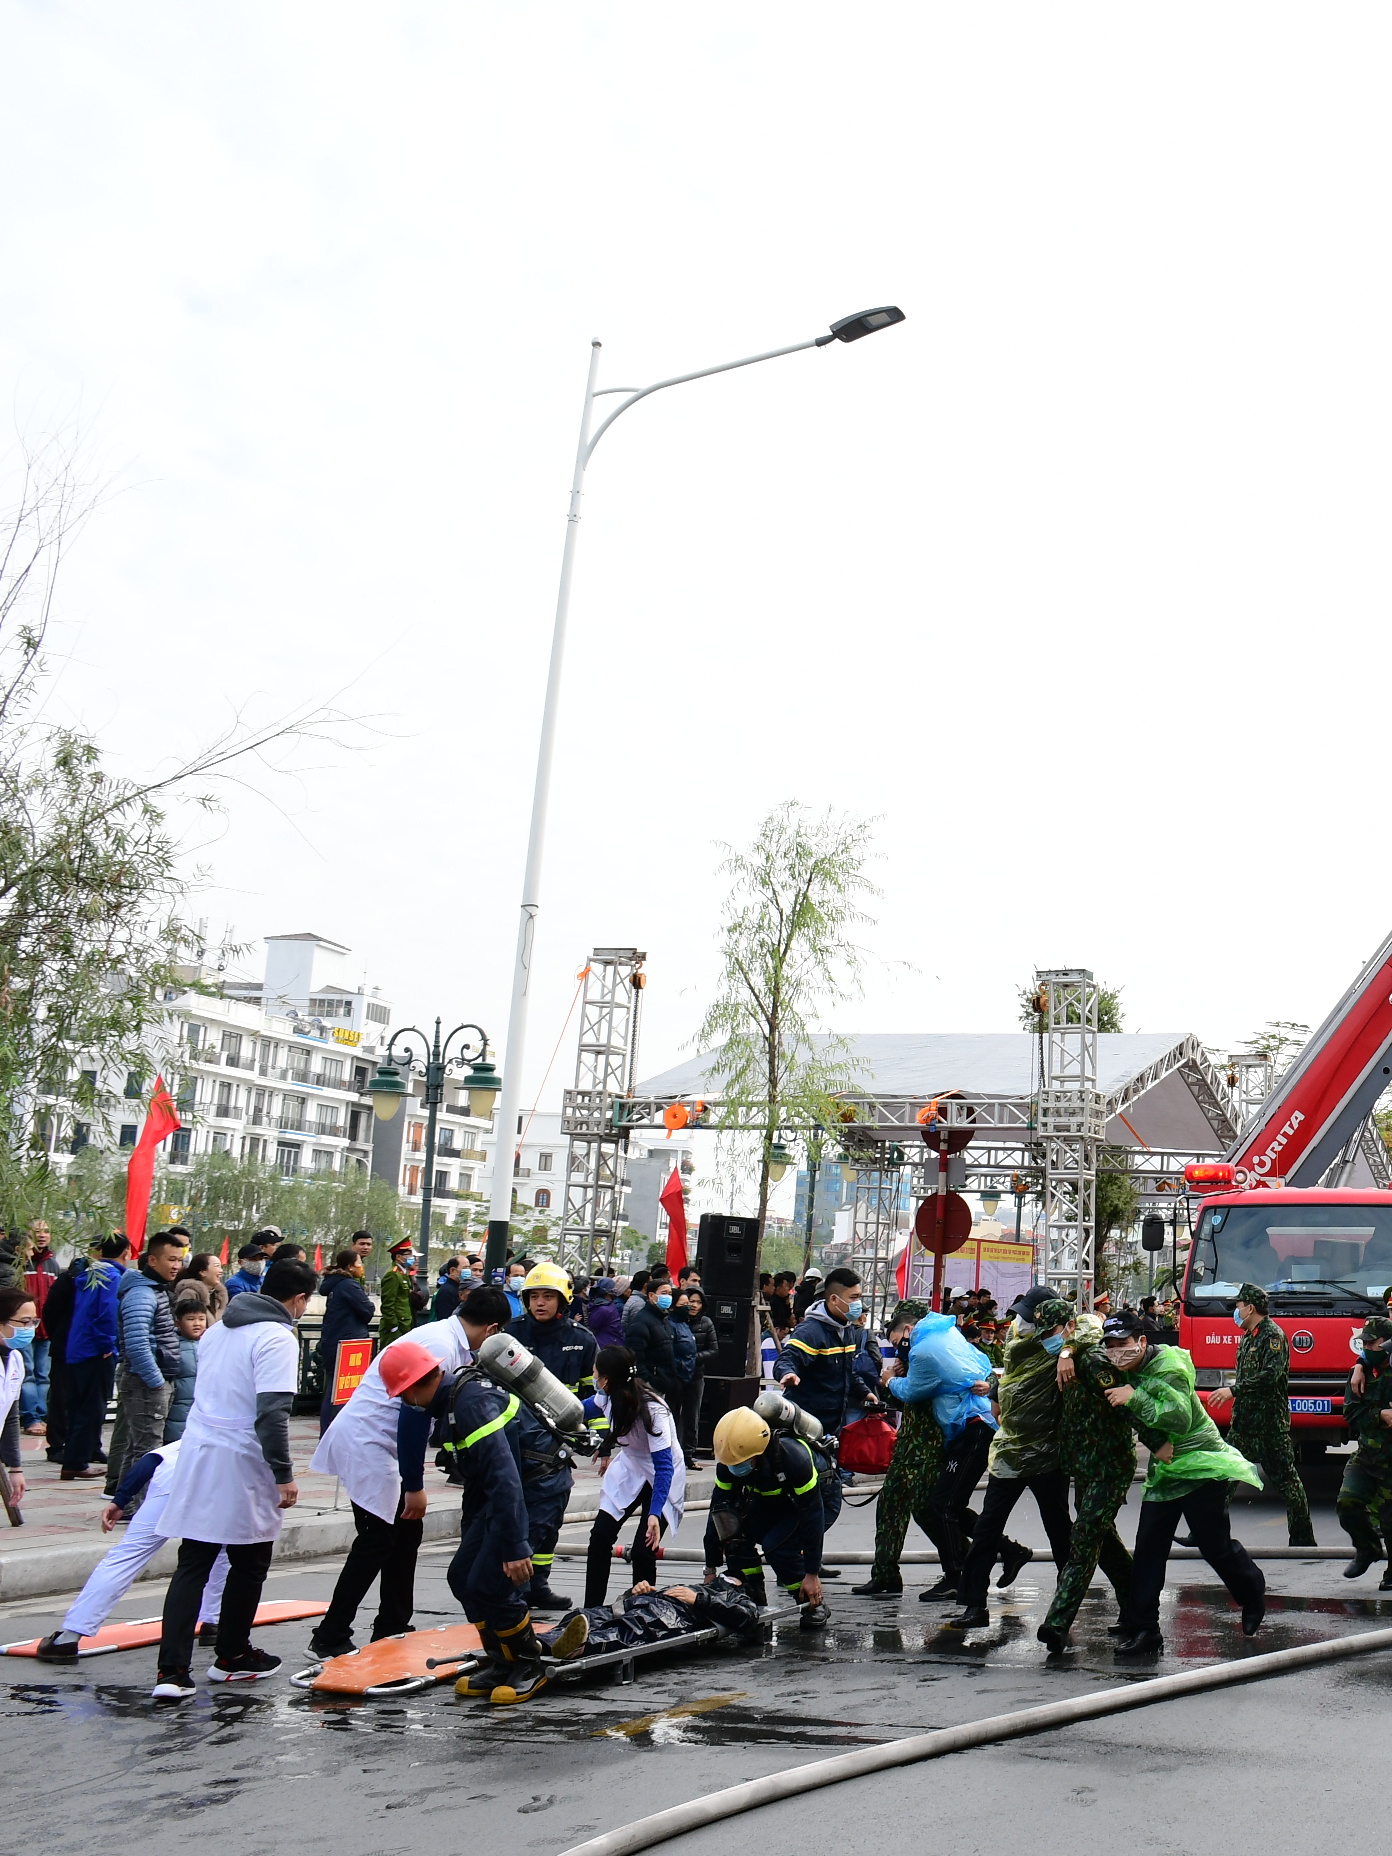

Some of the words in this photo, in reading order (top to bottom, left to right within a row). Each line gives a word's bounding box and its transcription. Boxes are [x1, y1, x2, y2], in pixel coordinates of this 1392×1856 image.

[729, 1225, 742, 1234] JBL
[720, 1305, 733, 1314] JBL
[1222, 1335, 1232, 1345] XE
